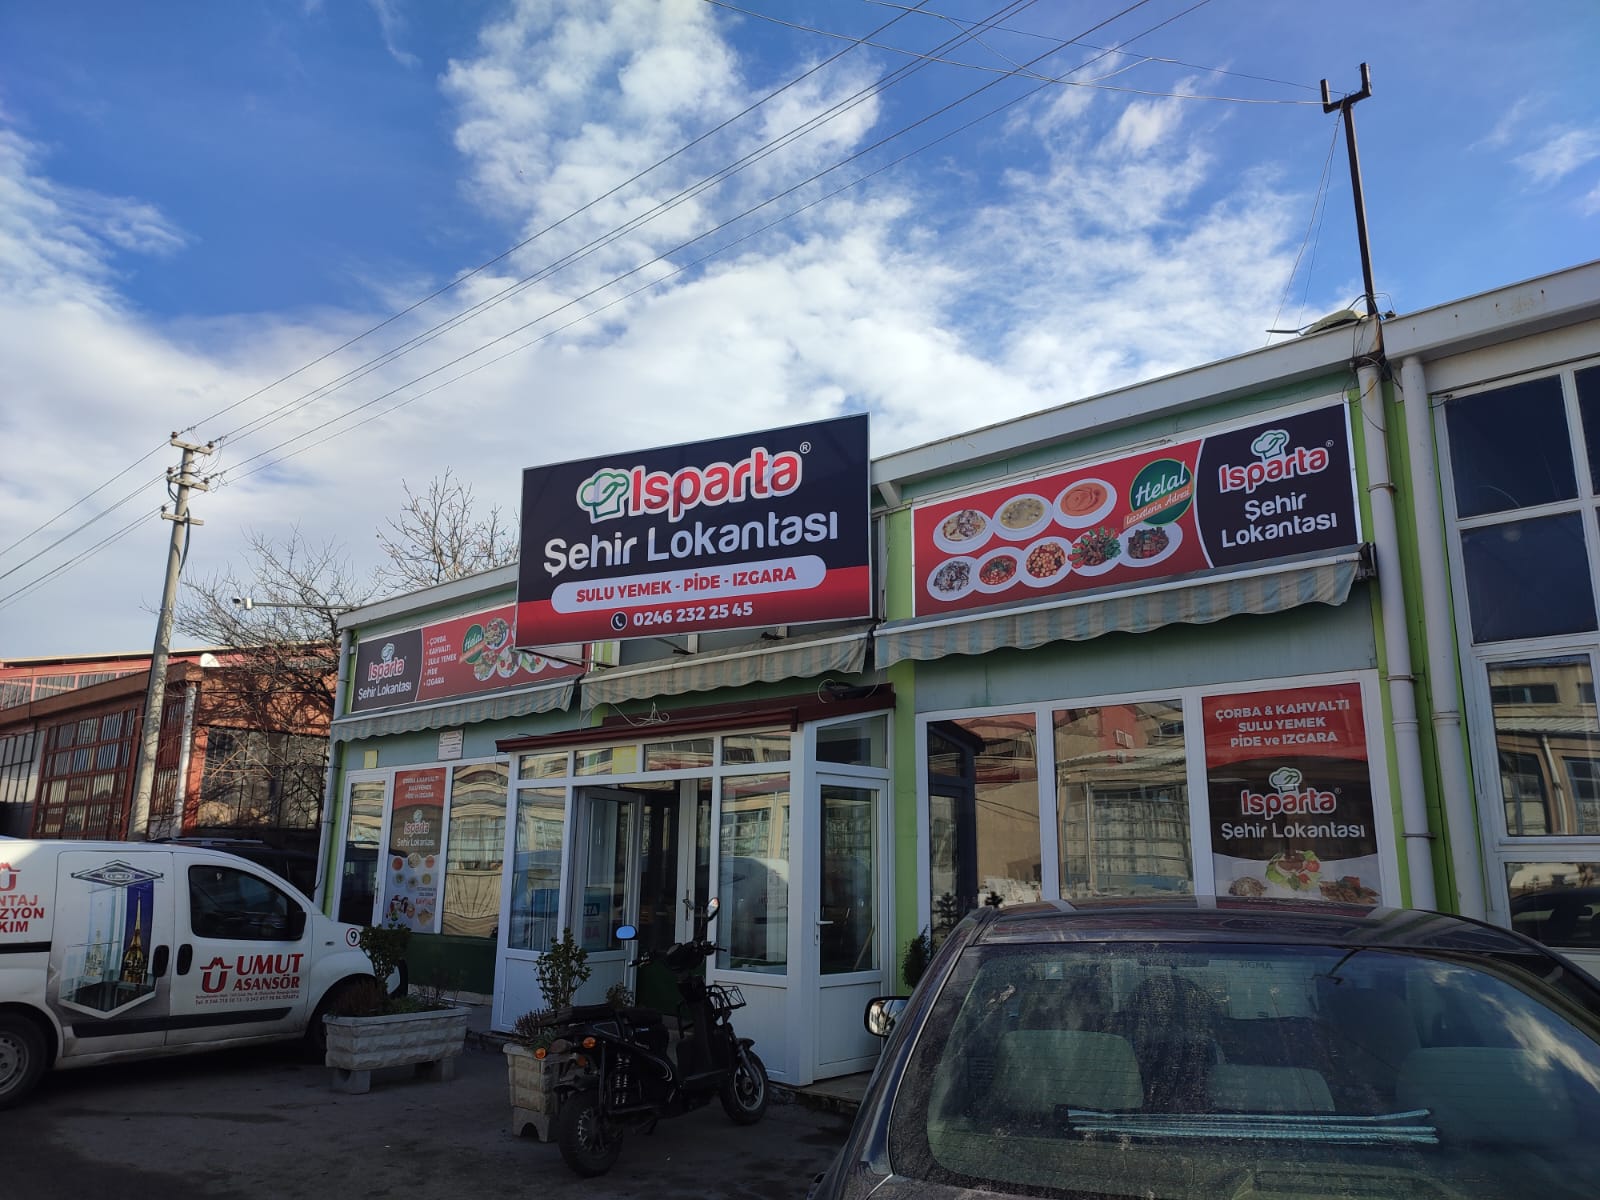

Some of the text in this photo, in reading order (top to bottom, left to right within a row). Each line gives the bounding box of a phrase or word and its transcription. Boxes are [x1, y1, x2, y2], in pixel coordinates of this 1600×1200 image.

[1135, 461, 1186, 506] Helal
[1219, 447, 1329, 494] Isparta
[630, 448, 801, 521] Isparta
[1245, 492, 1306, 521] Şehir
[1222, 513, 1337, 548] Lokantası
[543, 511, 838, 578] Şehir Lokantası
[576, 587, 614, 602] SULU
[618, 580, 672, 598] YEMEK
[684, 573, 720, 591] PİDE
[732, 566, 797, 587] IZGARA
[633, 601, 753, 627] 0246 232 25 45
[368, 657, 404, 684] Isparta
[377, 681, 411, 696] Lokantası
[1216, 699, 1350, 722] ÇORBA & KAHVALTI
[1238, 717, 1326, 733] SULU YEMEK
[1231, 731, 1338, 748] PİDE ve IZGARA
[1241, 787, 1336, 820] Isparta
[1221, 821, 1365, 840] Şehir Lokantası
[0, 907, 44, 919] ZYON
[350, 931, 358, 943] 9
[237, 954, 304, 975] UMUT
[233, 974, 300, 991] ASANSÖR
